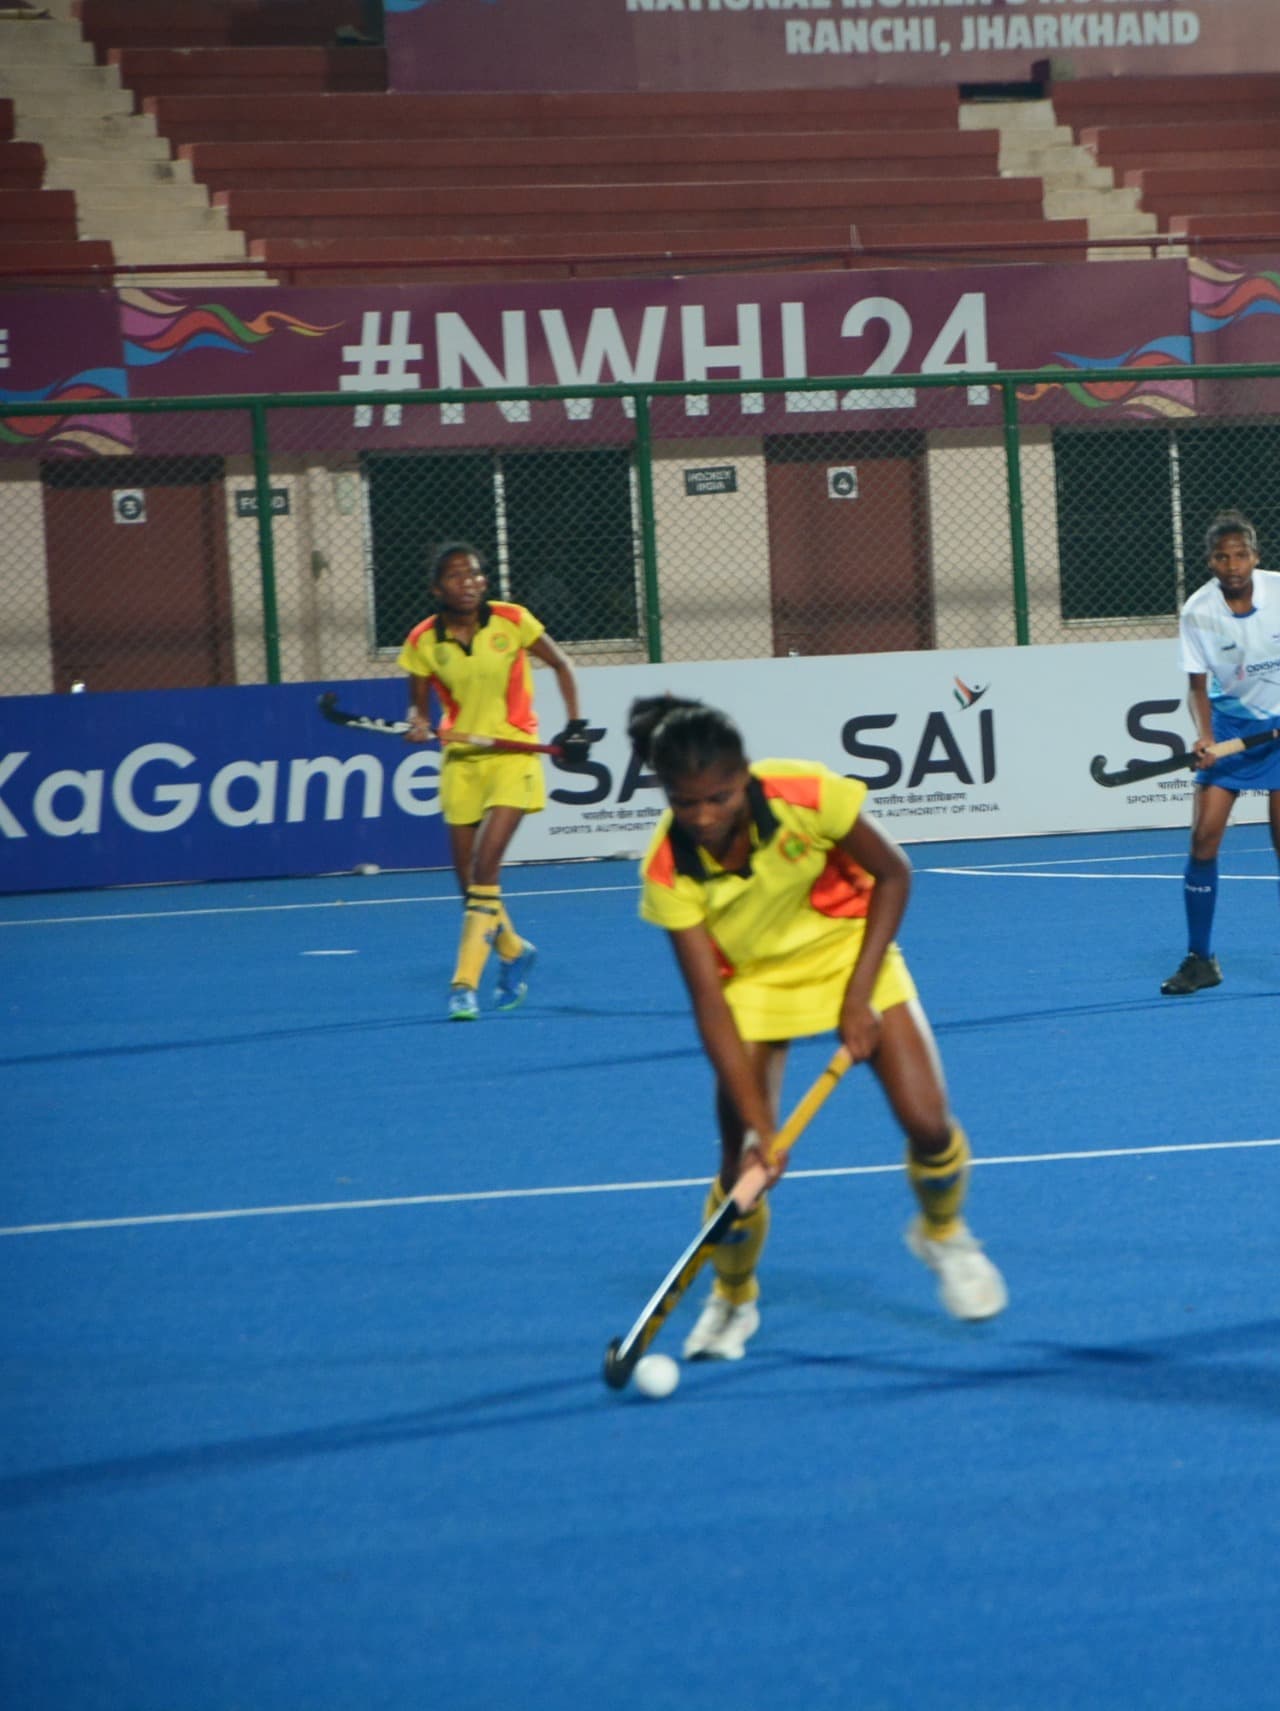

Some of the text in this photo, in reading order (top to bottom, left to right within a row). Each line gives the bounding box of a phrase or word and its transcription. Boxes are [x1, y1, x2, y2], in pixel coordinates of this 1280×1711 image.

[785, 11, 1199, 55] RANCHI, JHARKHAND
[338, 292, 998, 428] #NWHL24
[841, 708, 996, 791] SAI
[887, 804, 947, 817] AUTHORITY
[951, 803, 967, 814] OF
[970, 801, 999, 813] INDIA
